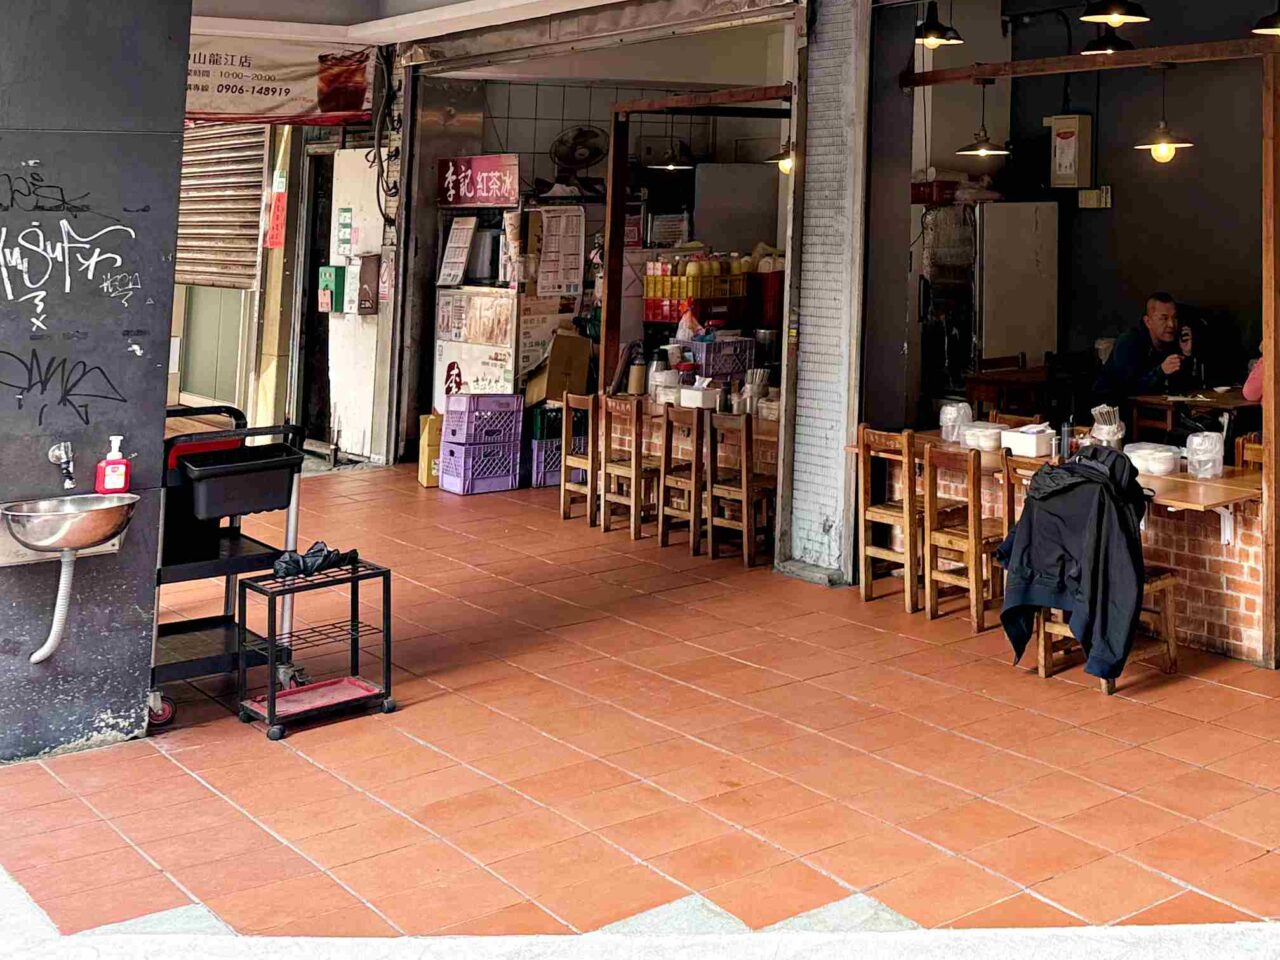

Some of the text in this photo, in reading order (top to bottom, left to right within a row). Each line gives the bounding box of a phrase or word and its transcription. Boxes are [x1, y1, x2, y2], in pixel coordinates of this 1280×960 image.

[216, 84, 291, 97] 0906-148919
[444, 161, 513, 202] 李記紅茶冰
